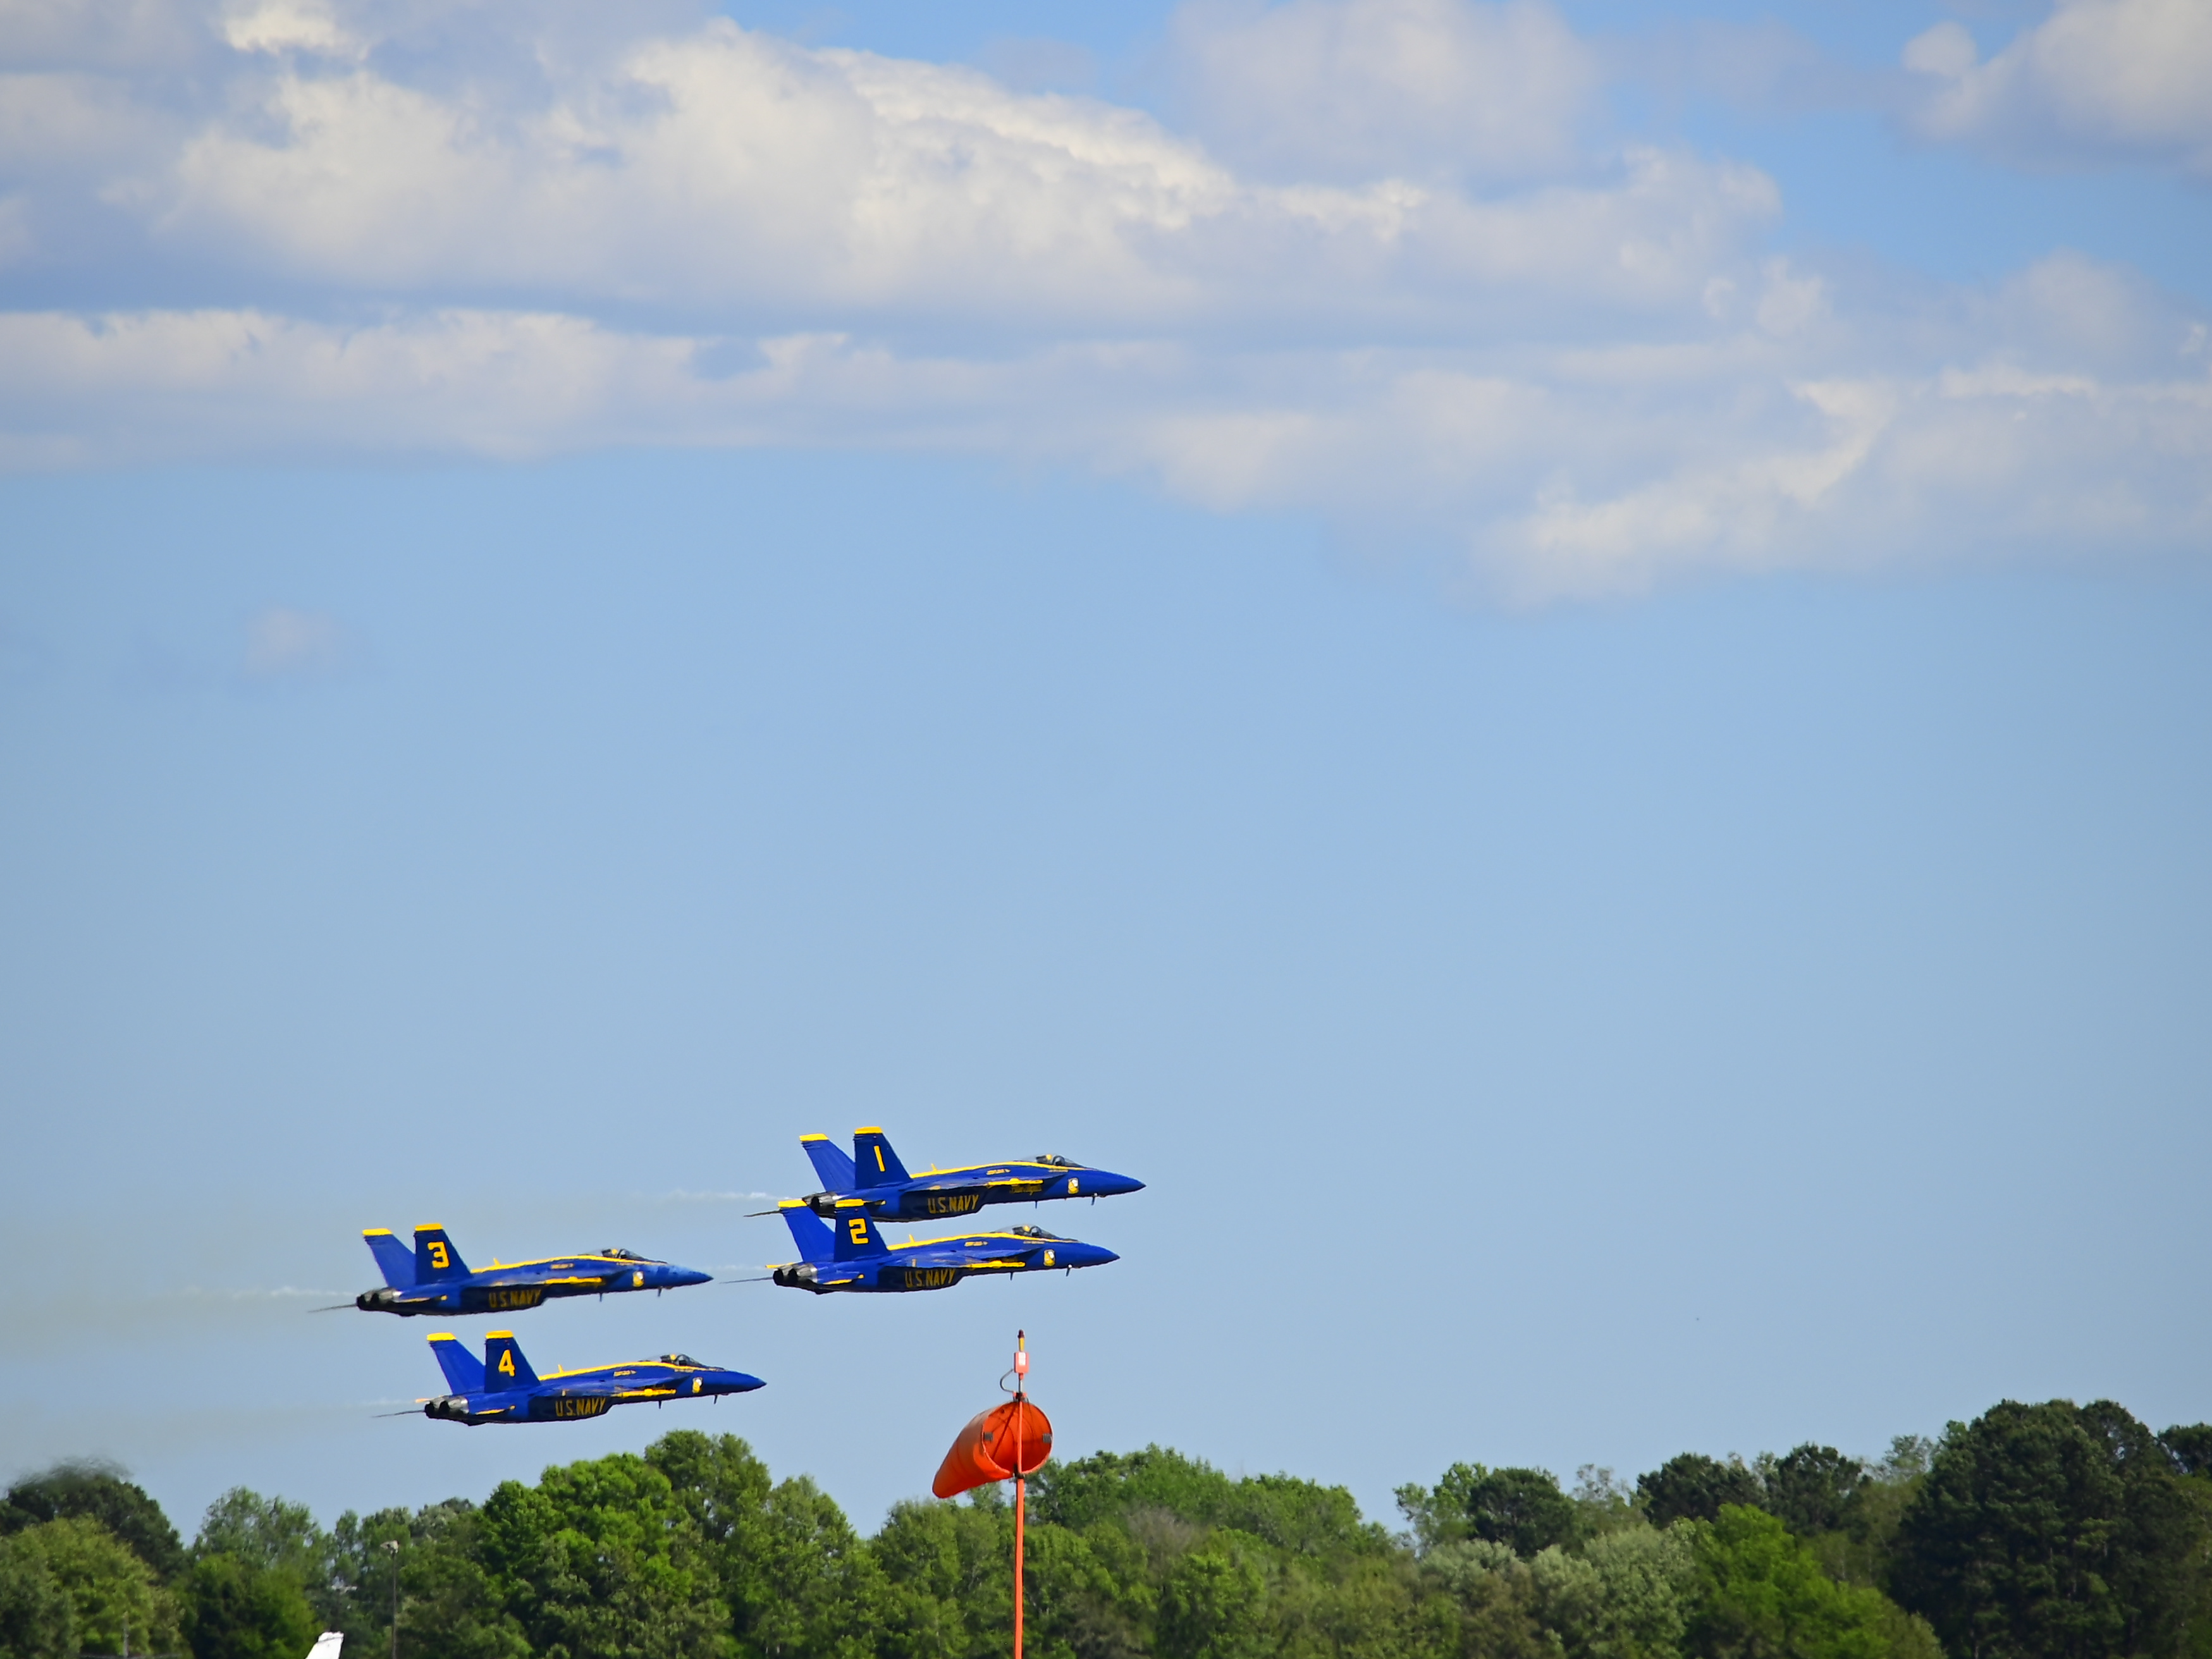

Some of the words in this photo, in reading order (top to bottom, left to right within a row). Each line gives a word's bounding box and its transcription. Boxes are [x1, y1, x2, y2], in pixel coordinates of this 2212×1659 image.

[874, 1145, 886, 1172] 1
[849, 1218, 869, 1244] 2
[427, 1241, 450, 1268] 3
[498, 1349, 515, 1377] 4
